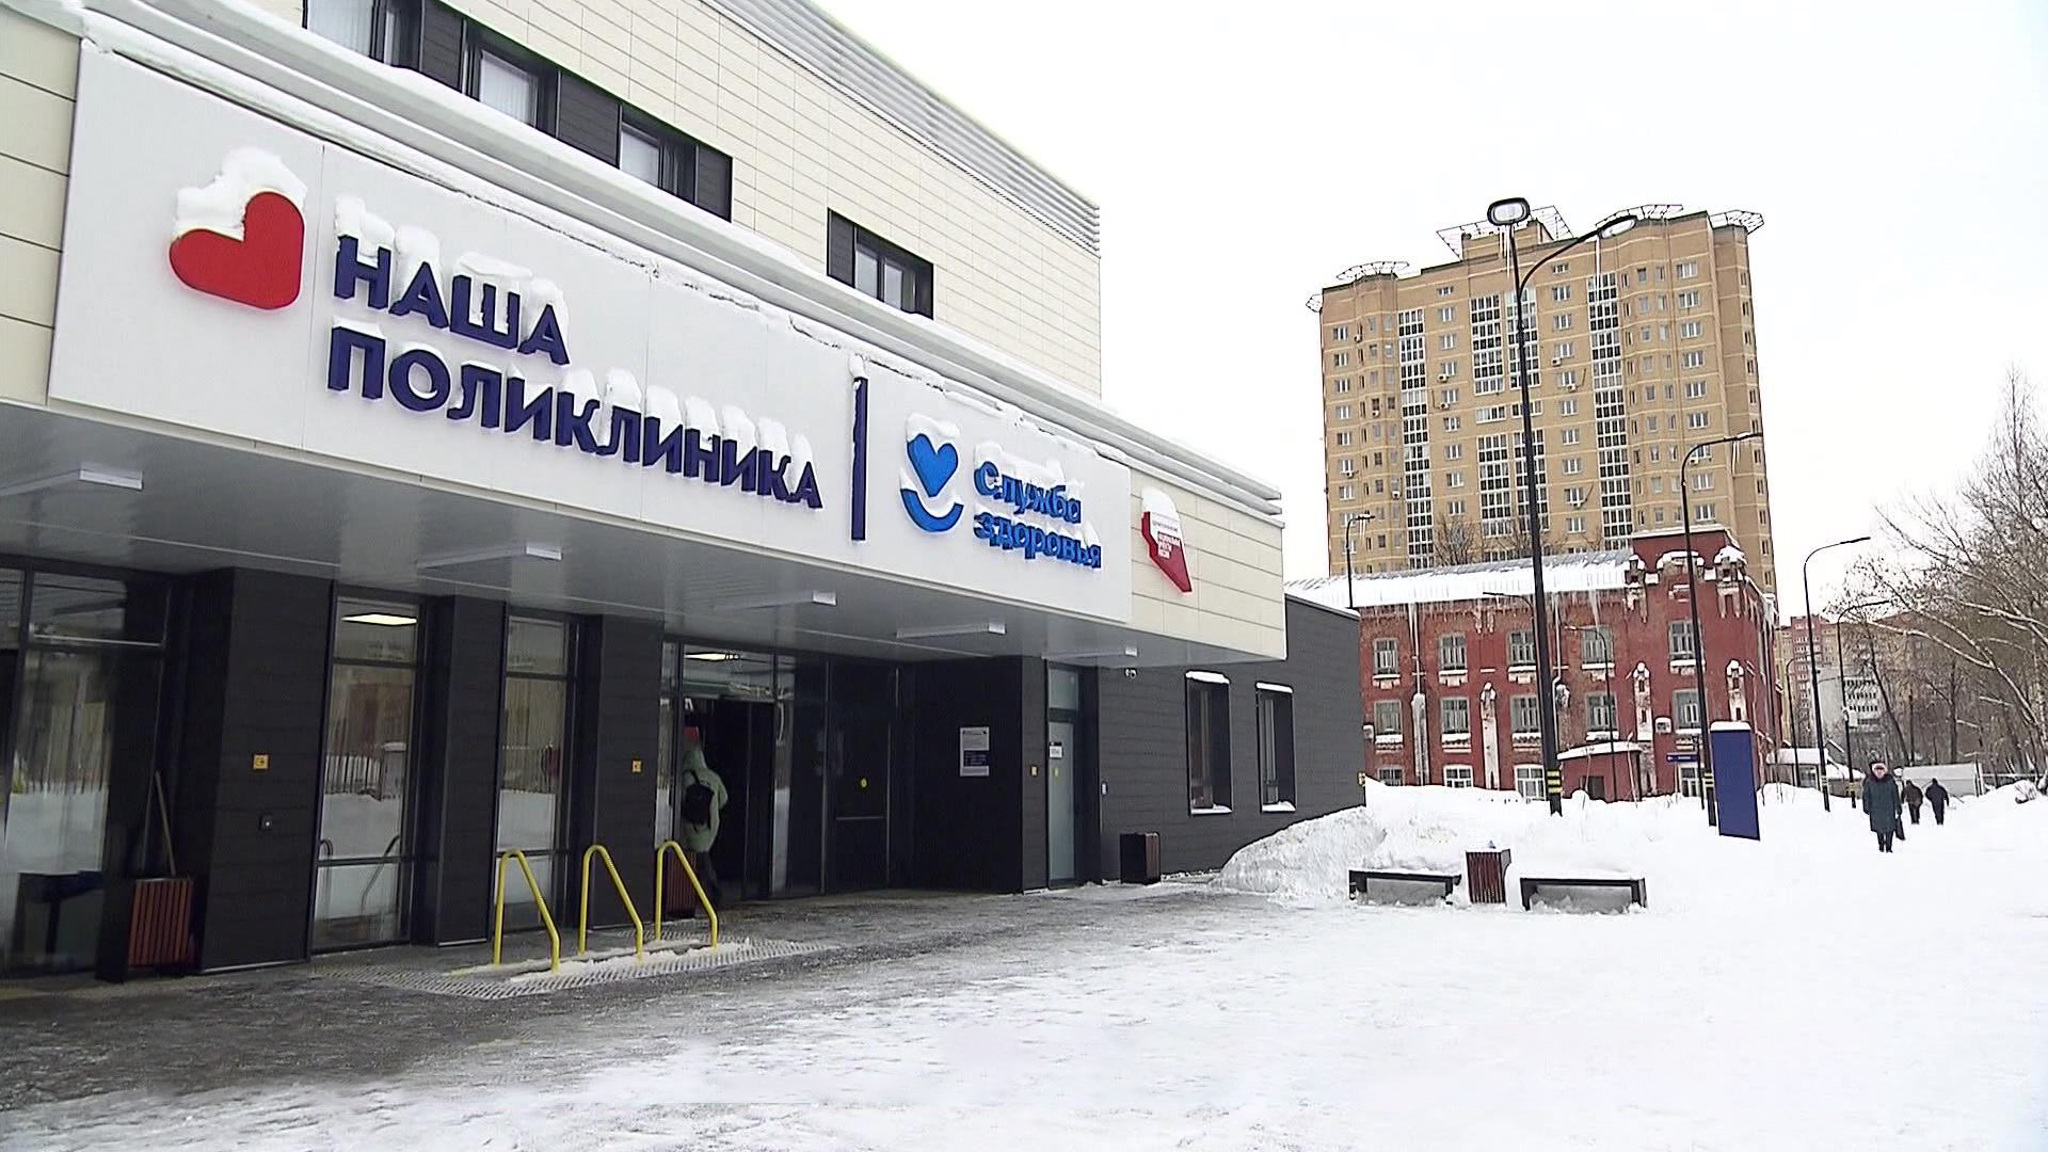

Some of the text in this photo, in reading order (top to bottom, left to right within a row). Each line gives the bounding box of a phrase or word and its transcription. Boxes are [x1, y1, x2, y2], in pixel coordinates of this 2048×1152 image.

[334, 234, 570, 366] НАША
[327, 325, 824, 510] ПОЛИКЛИНИКА
[973, 511, 1102, 569] здоровья
[974, 461, 1082, 524] Служба
